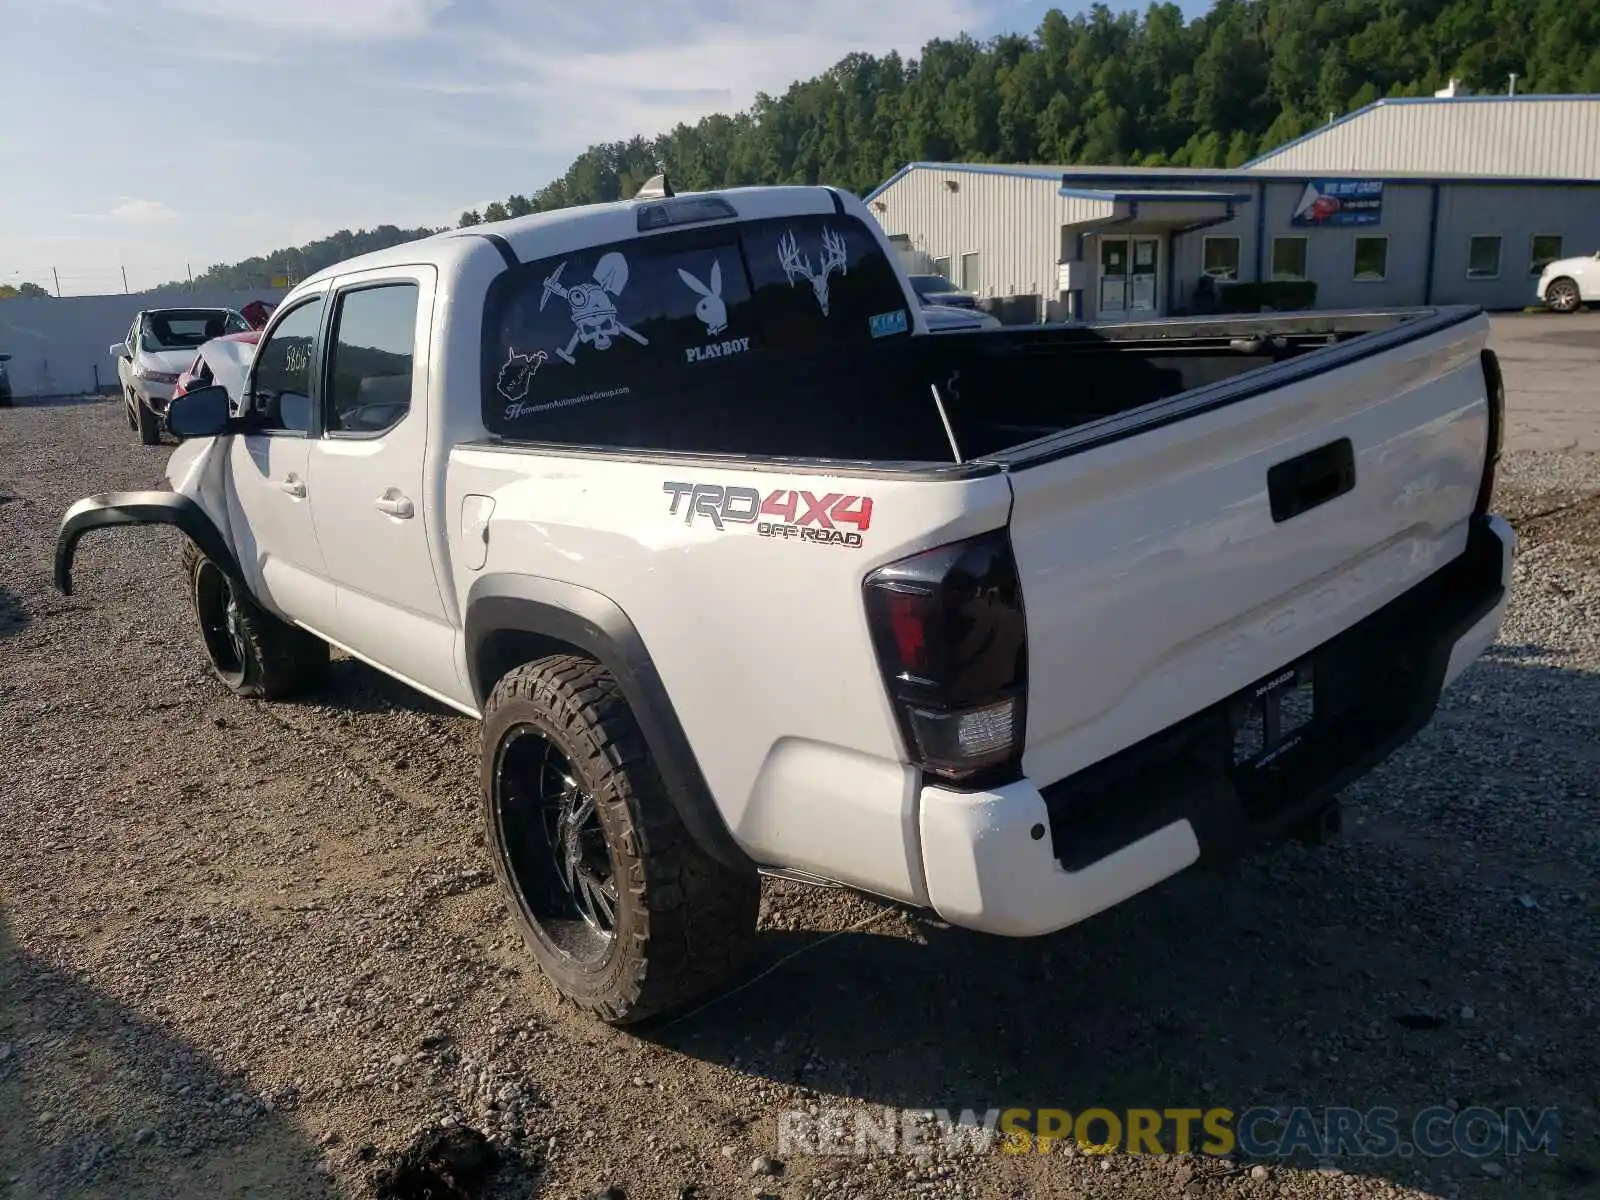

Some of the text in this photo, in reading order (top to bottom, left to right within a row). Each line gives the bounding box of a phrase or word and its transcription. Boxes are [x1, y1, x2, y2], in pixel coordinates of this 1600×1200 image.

[685, 337, 751, 363] PLAYBOY
[663, 481, 874, 531] TRD 4X4
[757, 522, 864, 549] OFF ROAD
